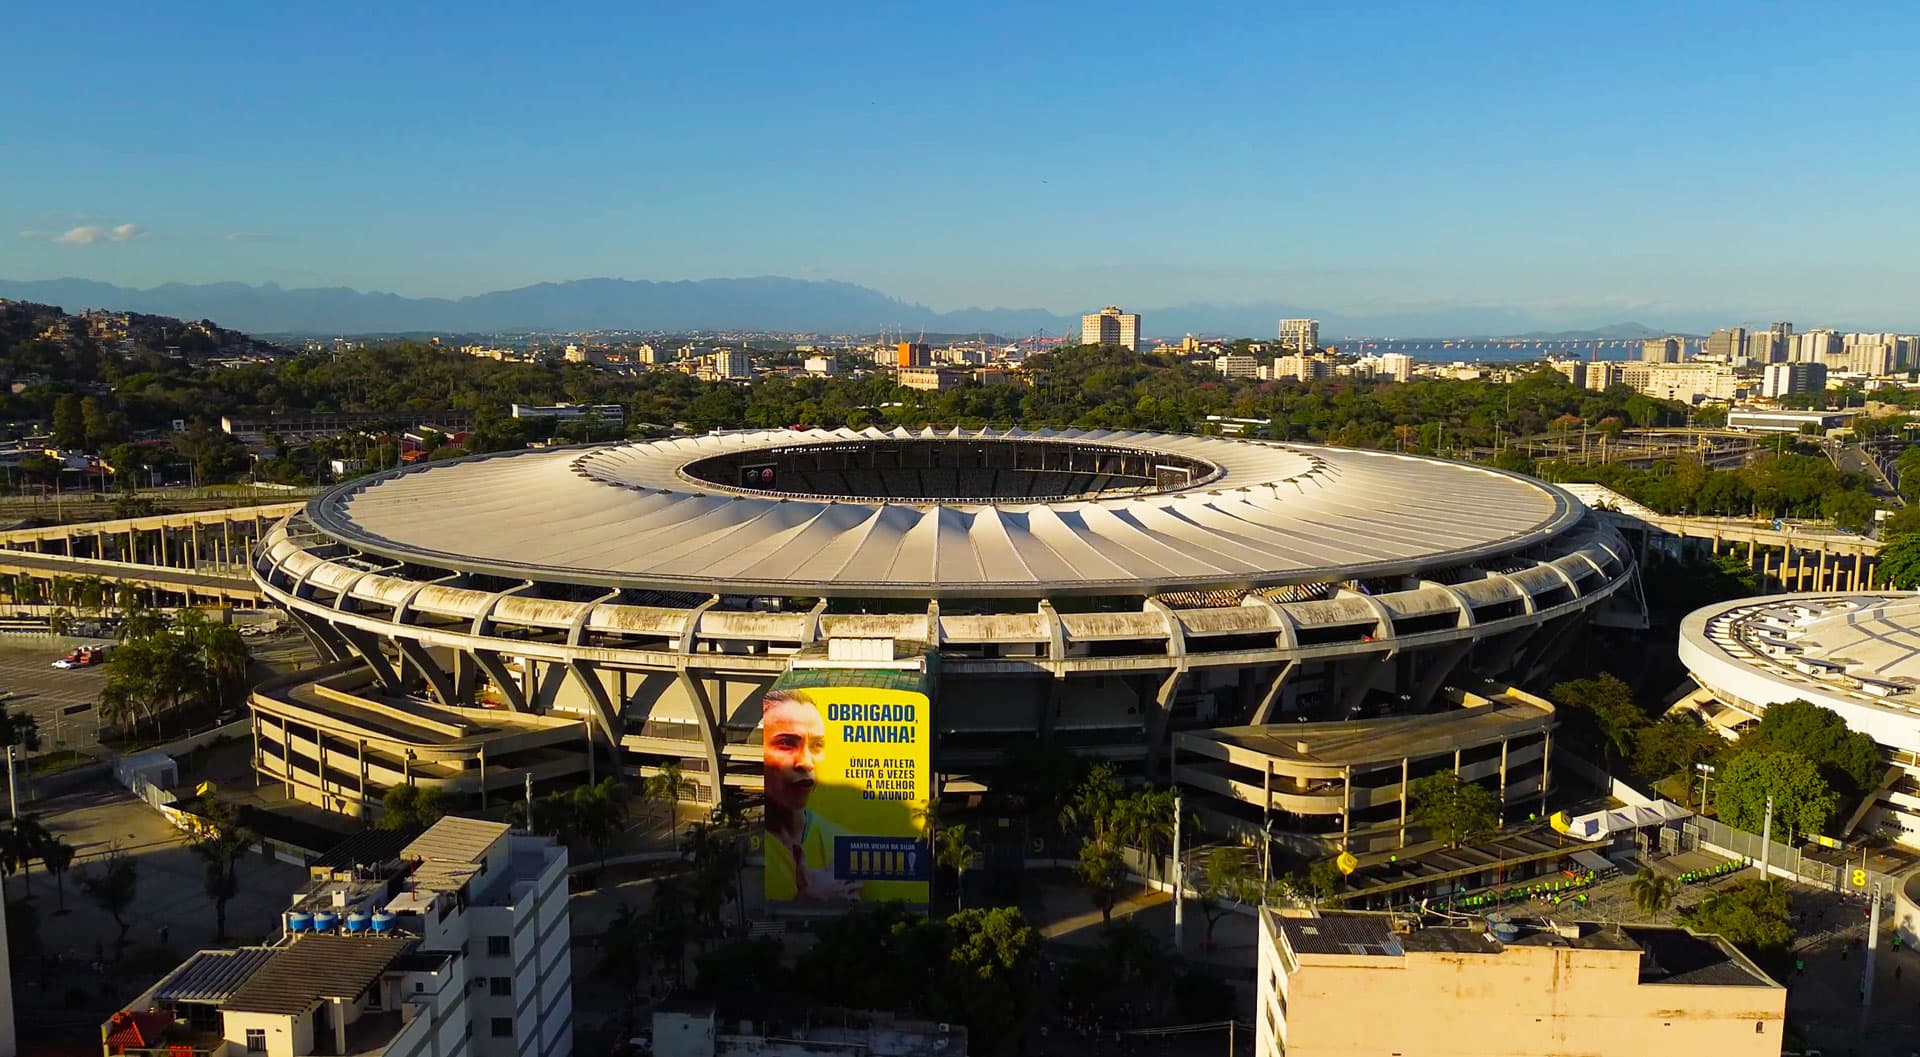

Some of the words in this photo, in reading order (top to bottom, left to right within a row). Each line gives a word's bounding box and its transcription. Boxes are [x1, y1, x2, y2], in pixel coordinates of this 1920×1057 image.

[828, 704, 918, 724] OBRIGADO,
[843, 725, 915, 744] RAINHA!
[850, 756, 880, 769] ÚNICA
[883, 758, 915, 769] ATLETA
[845, 769, 875, 779] ELEITA
[878, 769, 884, 779] 6
[887, 769, 915, 780] VEZES
[866, 780, 873, 790] A
[875, 780, 915, 790] MELHOR
[863, 790, 875, 800] DO
[878, 791, 915, 801] MUNDO
[1852, 869, 1866, 887] 8
